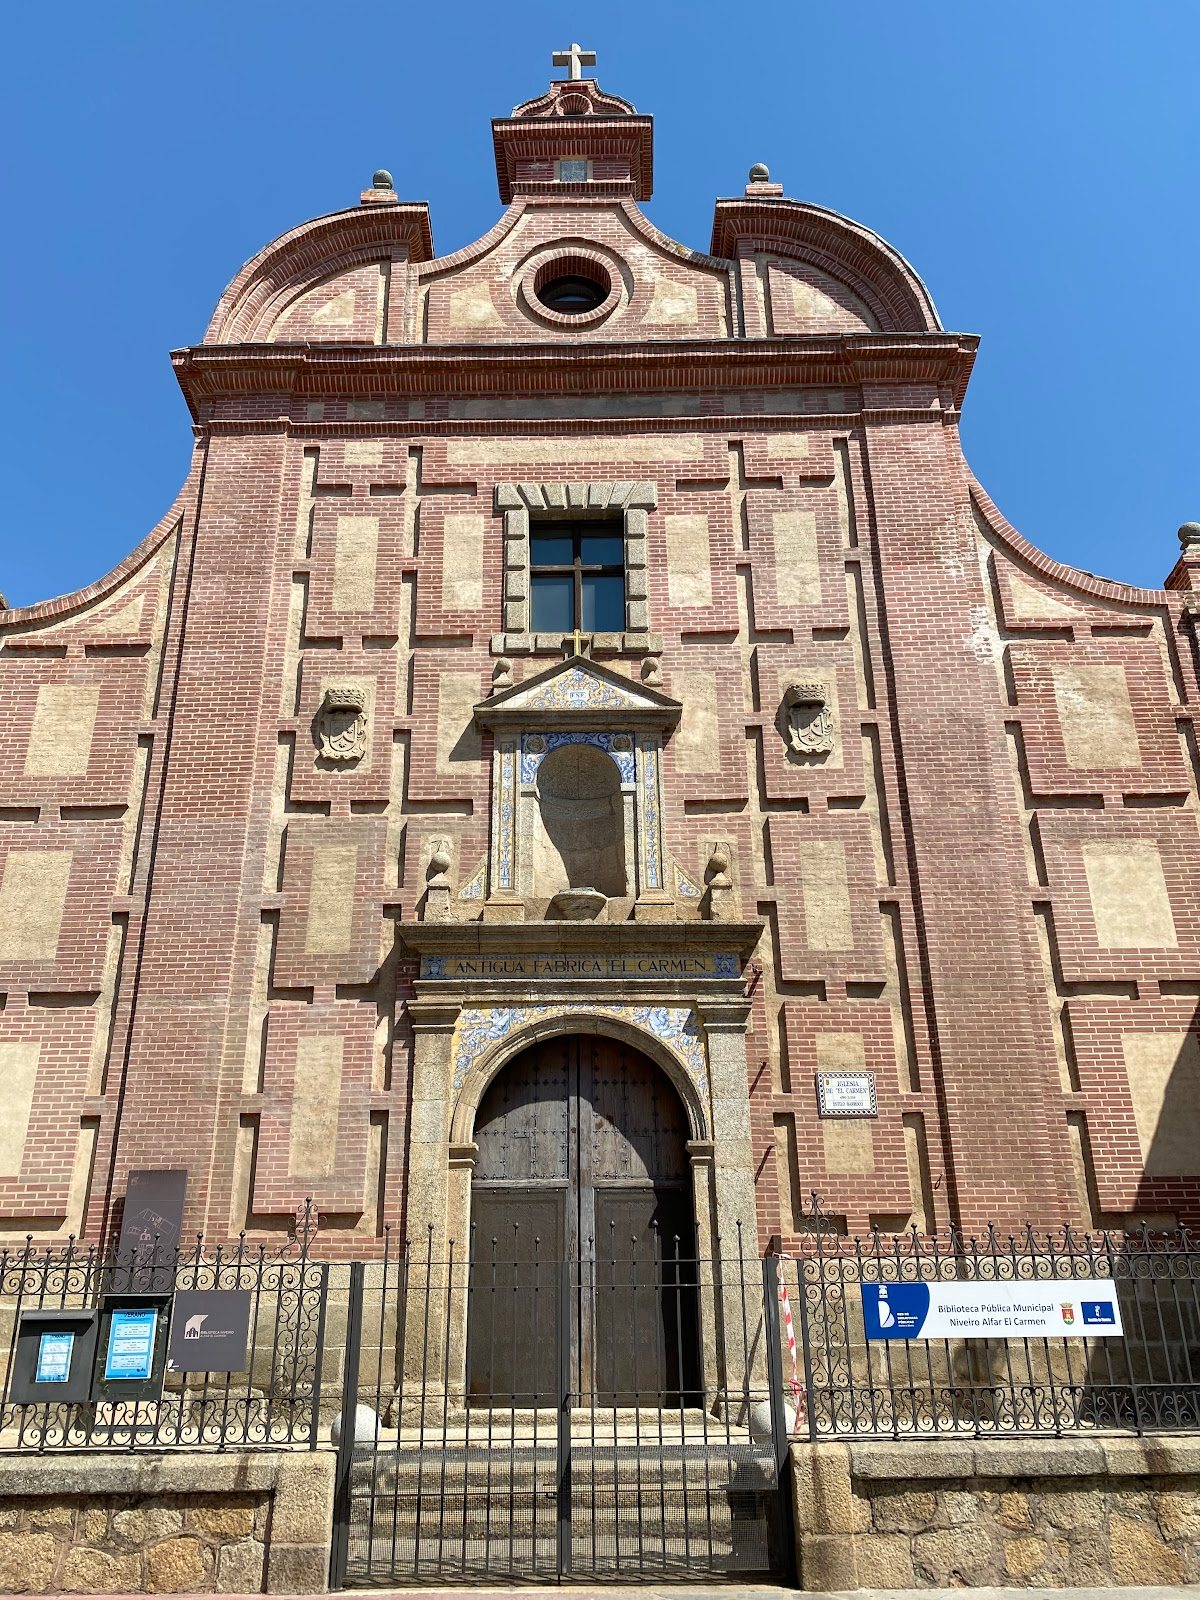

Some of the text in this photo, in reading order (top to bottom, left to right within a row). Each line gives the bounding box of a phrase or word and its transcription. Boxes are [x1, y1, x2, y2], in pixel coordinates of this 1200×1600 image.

[456, 960, 524, 973] ANTIGUA
[534, 960, 602, 974] FABRICA
[938, 1303, 1054, 1313] Biblioteca Pública Municipal
[949, 1317, 1046, 1327] Niveiro Alfar El Carmen
